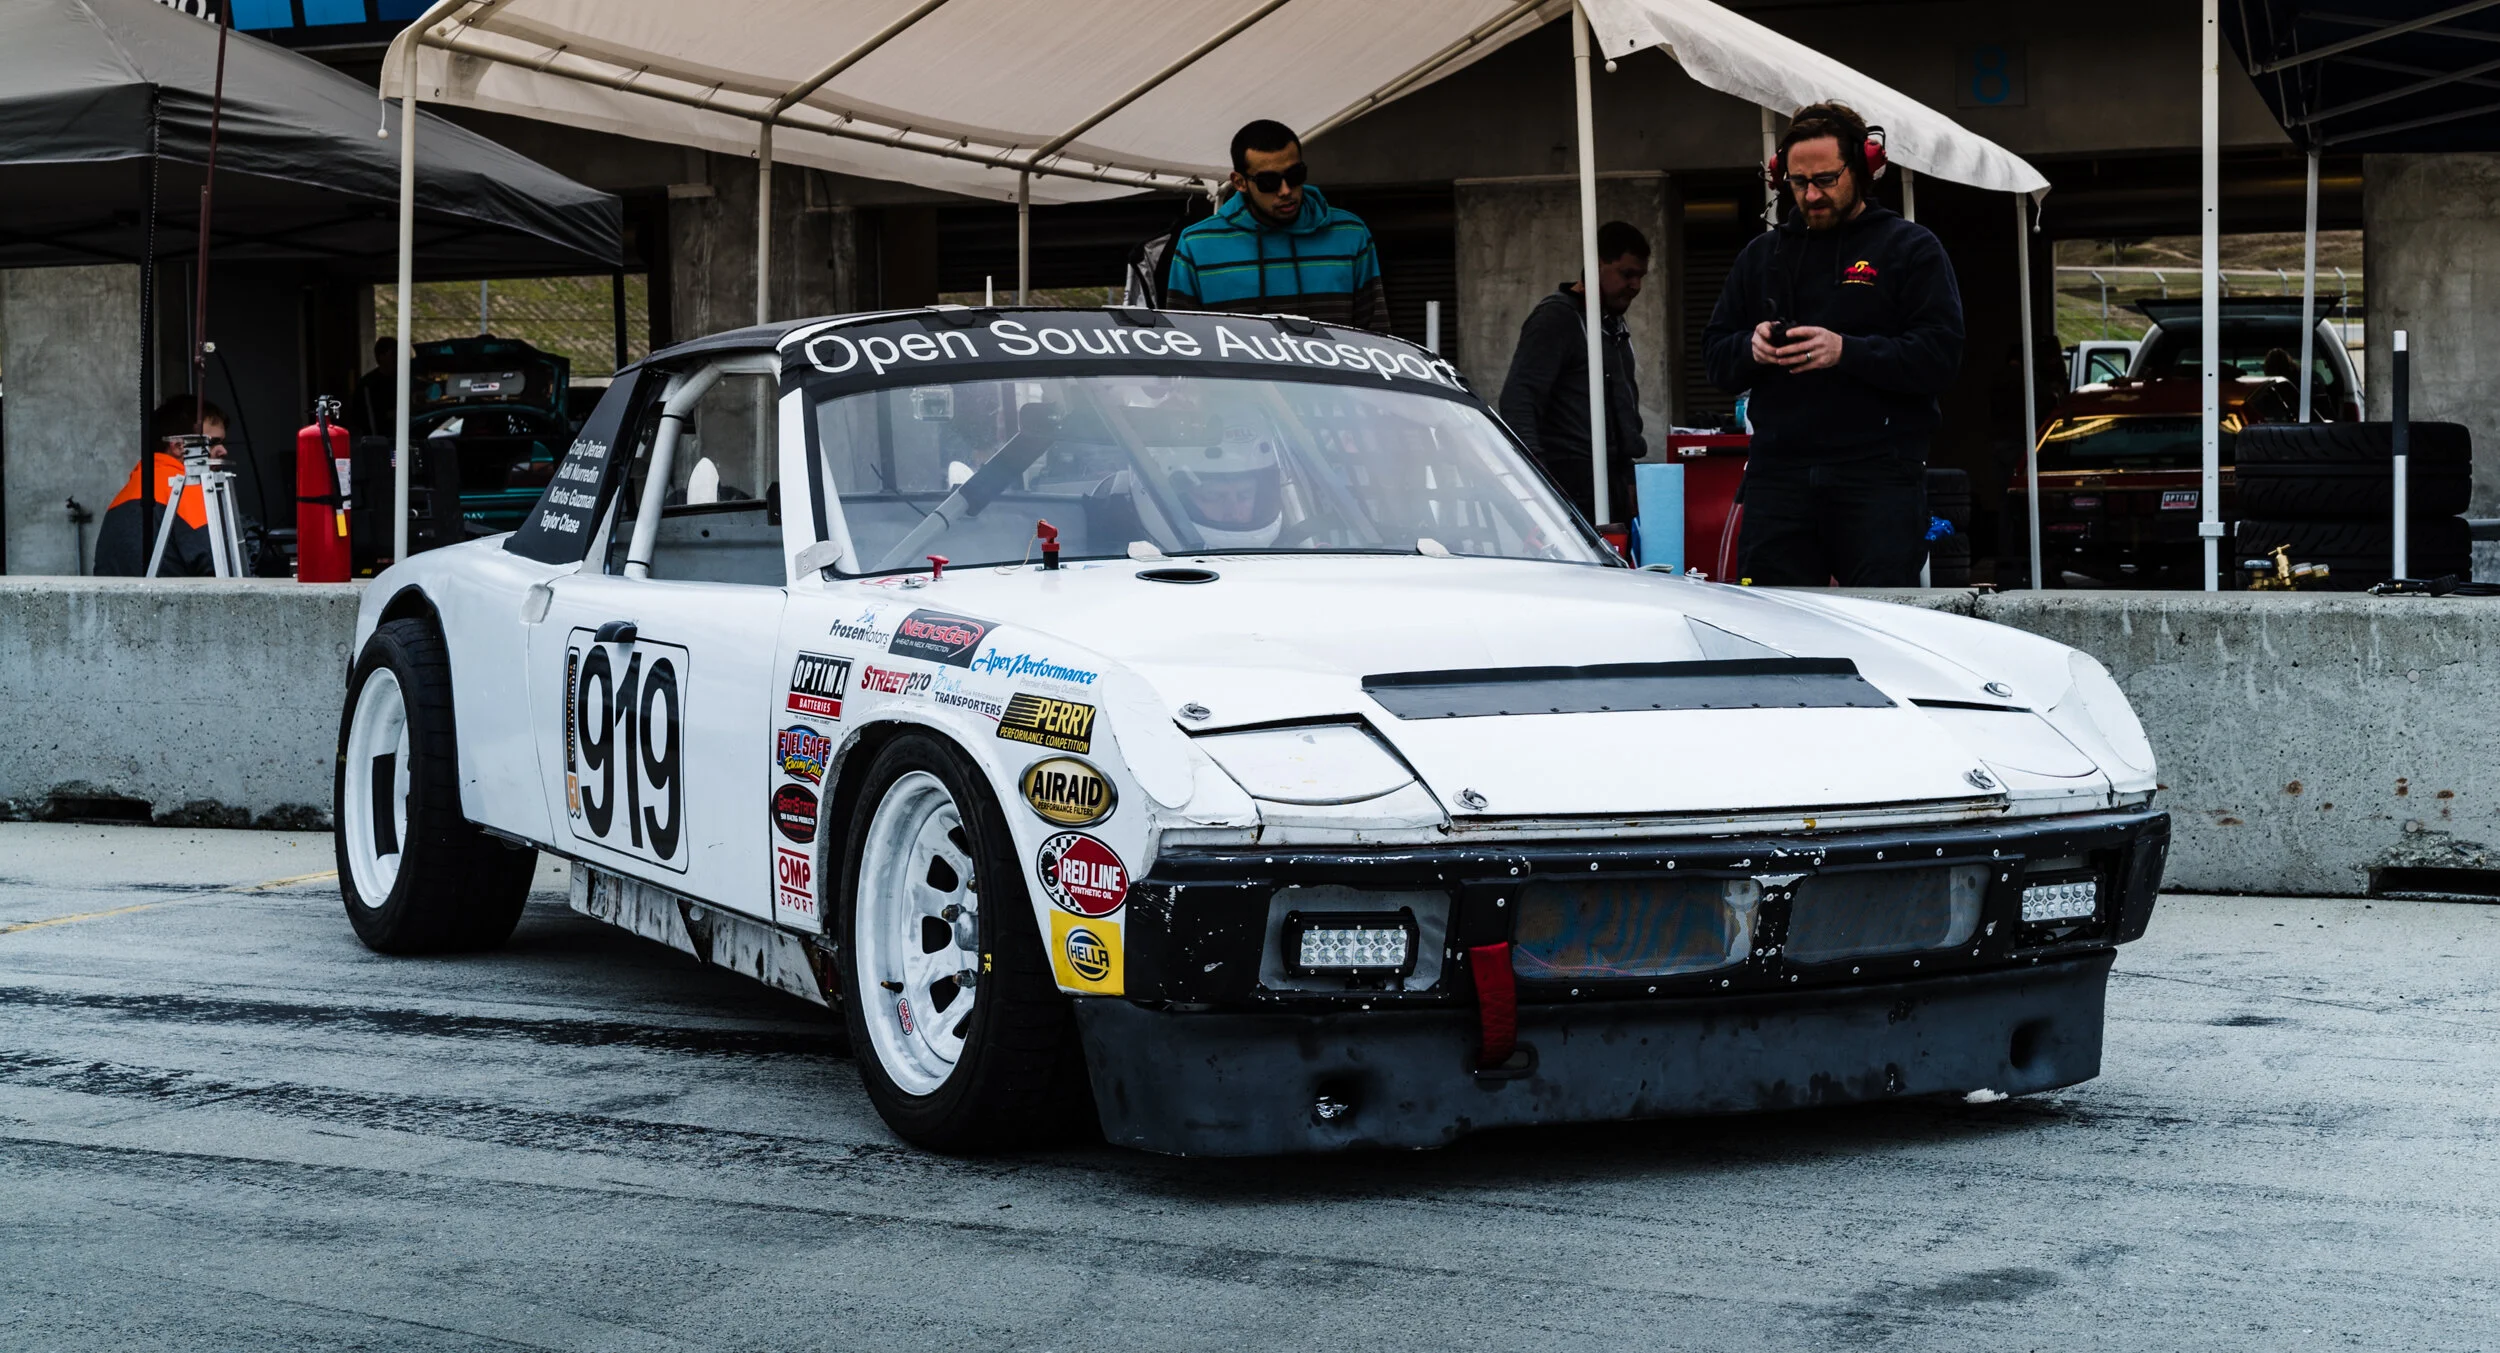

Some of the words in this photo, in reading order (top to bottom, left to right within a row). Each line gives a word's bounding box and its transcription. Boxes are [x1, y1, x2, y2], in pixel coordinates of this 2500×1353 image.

[1972, 43, 2011, 106] 8
[805, 330, 979, 375] Open
[989, 320, 1202, 357] Source
[1215, 325, 1469, 393] Autosport
[569, 438, 587, 460] Craig
[548, 485, 570, 505] Karlos
[568, 488, 597, 509] Guzman
[2165, 494, 2195, 502] OPTIMA
[540, 509, 561, 532] Taylor
[558, 513, 580, 534] Chase
[829, 618, 890, 646] FrozenRotors
[925, 643, 950, 653] PROTECTION
[793, 659, 847, 695] OPTIMA
[799, 698, 831, 713] BATTERIES
[935, 691, 1002, 716] TRANSPORTERS
[1034, 698, 1095, 737] PERRY
[777, 730, 801, 761] FUEL
[802, 733, 831, 768] SAFE
[1000, 726, 1045, 745] PERFORMANCE
[1045, 734, 1089, 753] COMPETITION
[578, 644, 681, 861] 919
[784, 755, 807, 774] Racing
[1031, 770, 1103, 807] AIRAID
[1038, 801, 1072, 814] PERFORMANCE
[1074, 805, 1094, 817] FILTERS
[779, 855, 811, 890] OMP
[1062, 857, 1088, 886] RED
[1091, 862, 1121, 892] LINE
[780, 892, 814, 915] SPORT
[1070, 885, 1101, 898] SYNTHETIC
[1103, 891, 1113, 900] OIL
[1070, 945, 1110, 968] HELLA
